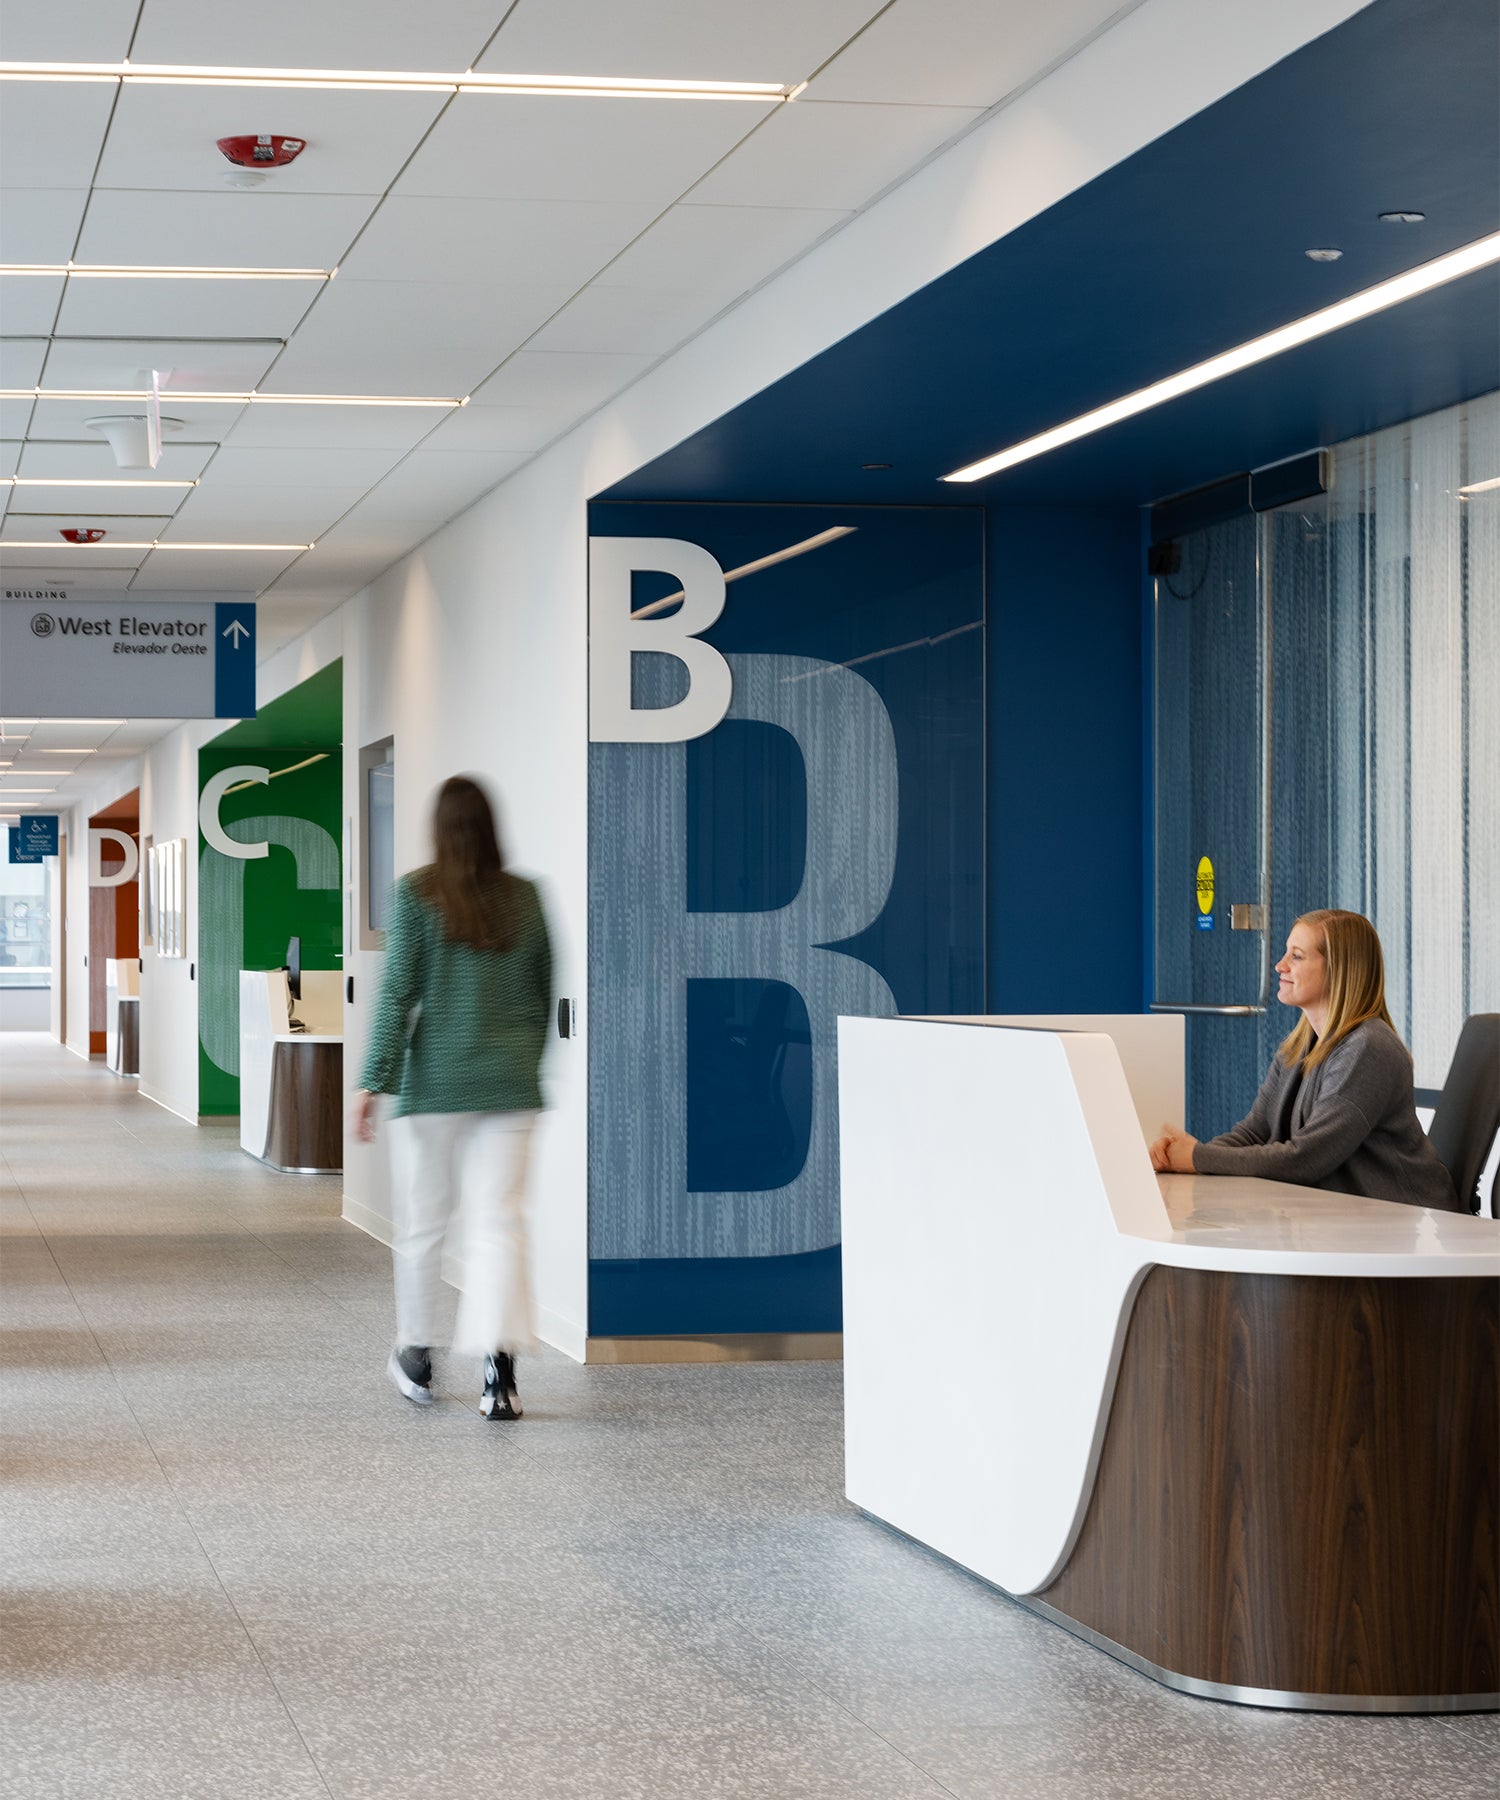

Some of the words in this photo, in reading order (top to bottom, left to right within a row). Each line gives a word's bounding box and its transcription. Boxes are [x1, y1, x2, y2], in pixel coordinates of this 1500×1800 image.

[6, 590, 67, 599] BUILDING
[58, 617, 112, 636] West
[119, 617, 207, 636] Elevator
[588, 536, 732, 743] B
[112, 642, 167, 655] Elevador
[171, 642, 208, 655] Oeste
[199, 765, 270, 860] C
[89, 828, 138, 888] D
